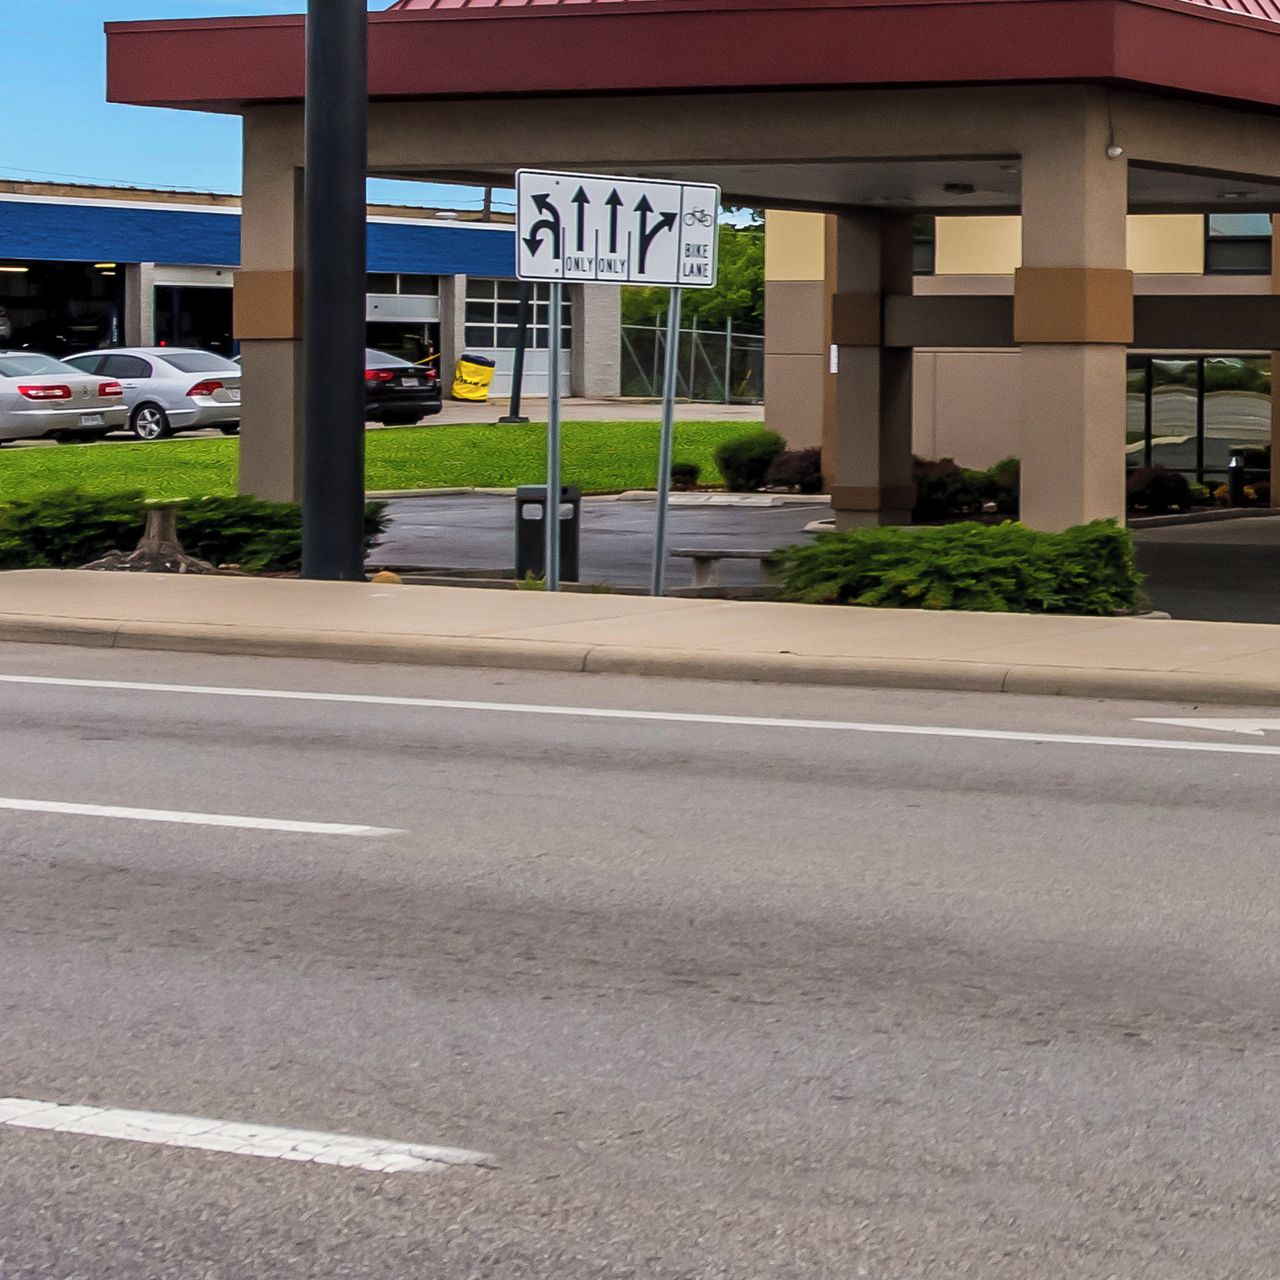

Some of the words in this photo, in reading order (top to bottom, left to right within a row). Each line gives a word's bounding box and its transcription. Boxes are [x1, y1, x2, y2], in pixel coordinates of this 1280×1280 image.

[684, 243, 709, 259] BIKE
[565, 256, 594, 273] ONLY
[598, 257, 626, 274] ONLY
[683, 262, 709, 278] LANE
